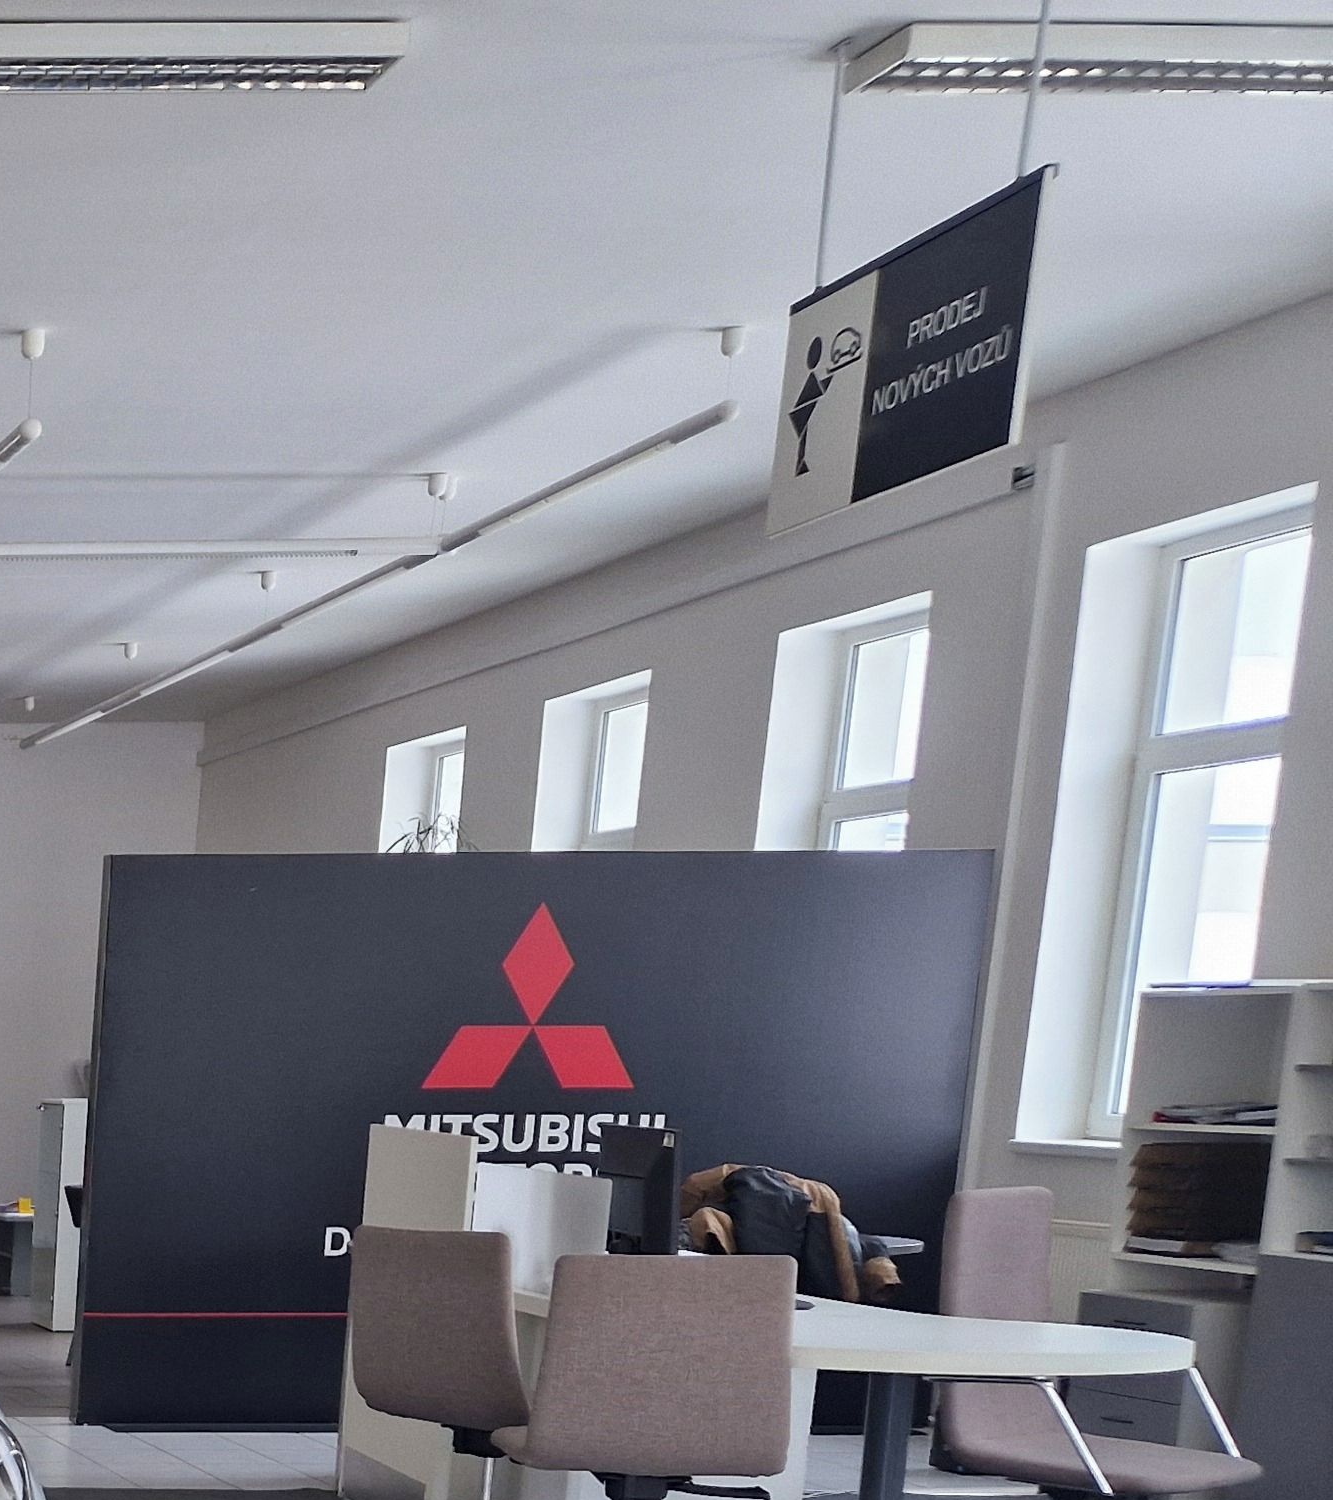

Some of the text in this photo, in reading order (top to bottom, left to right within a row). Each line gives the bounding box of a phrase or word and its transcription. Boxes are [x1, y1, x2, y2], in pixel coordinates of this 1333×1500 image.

[906, 286, 988, 349] PRODEJ
[871, 323, 1014, 416] NOVÝCH VOZŮ
